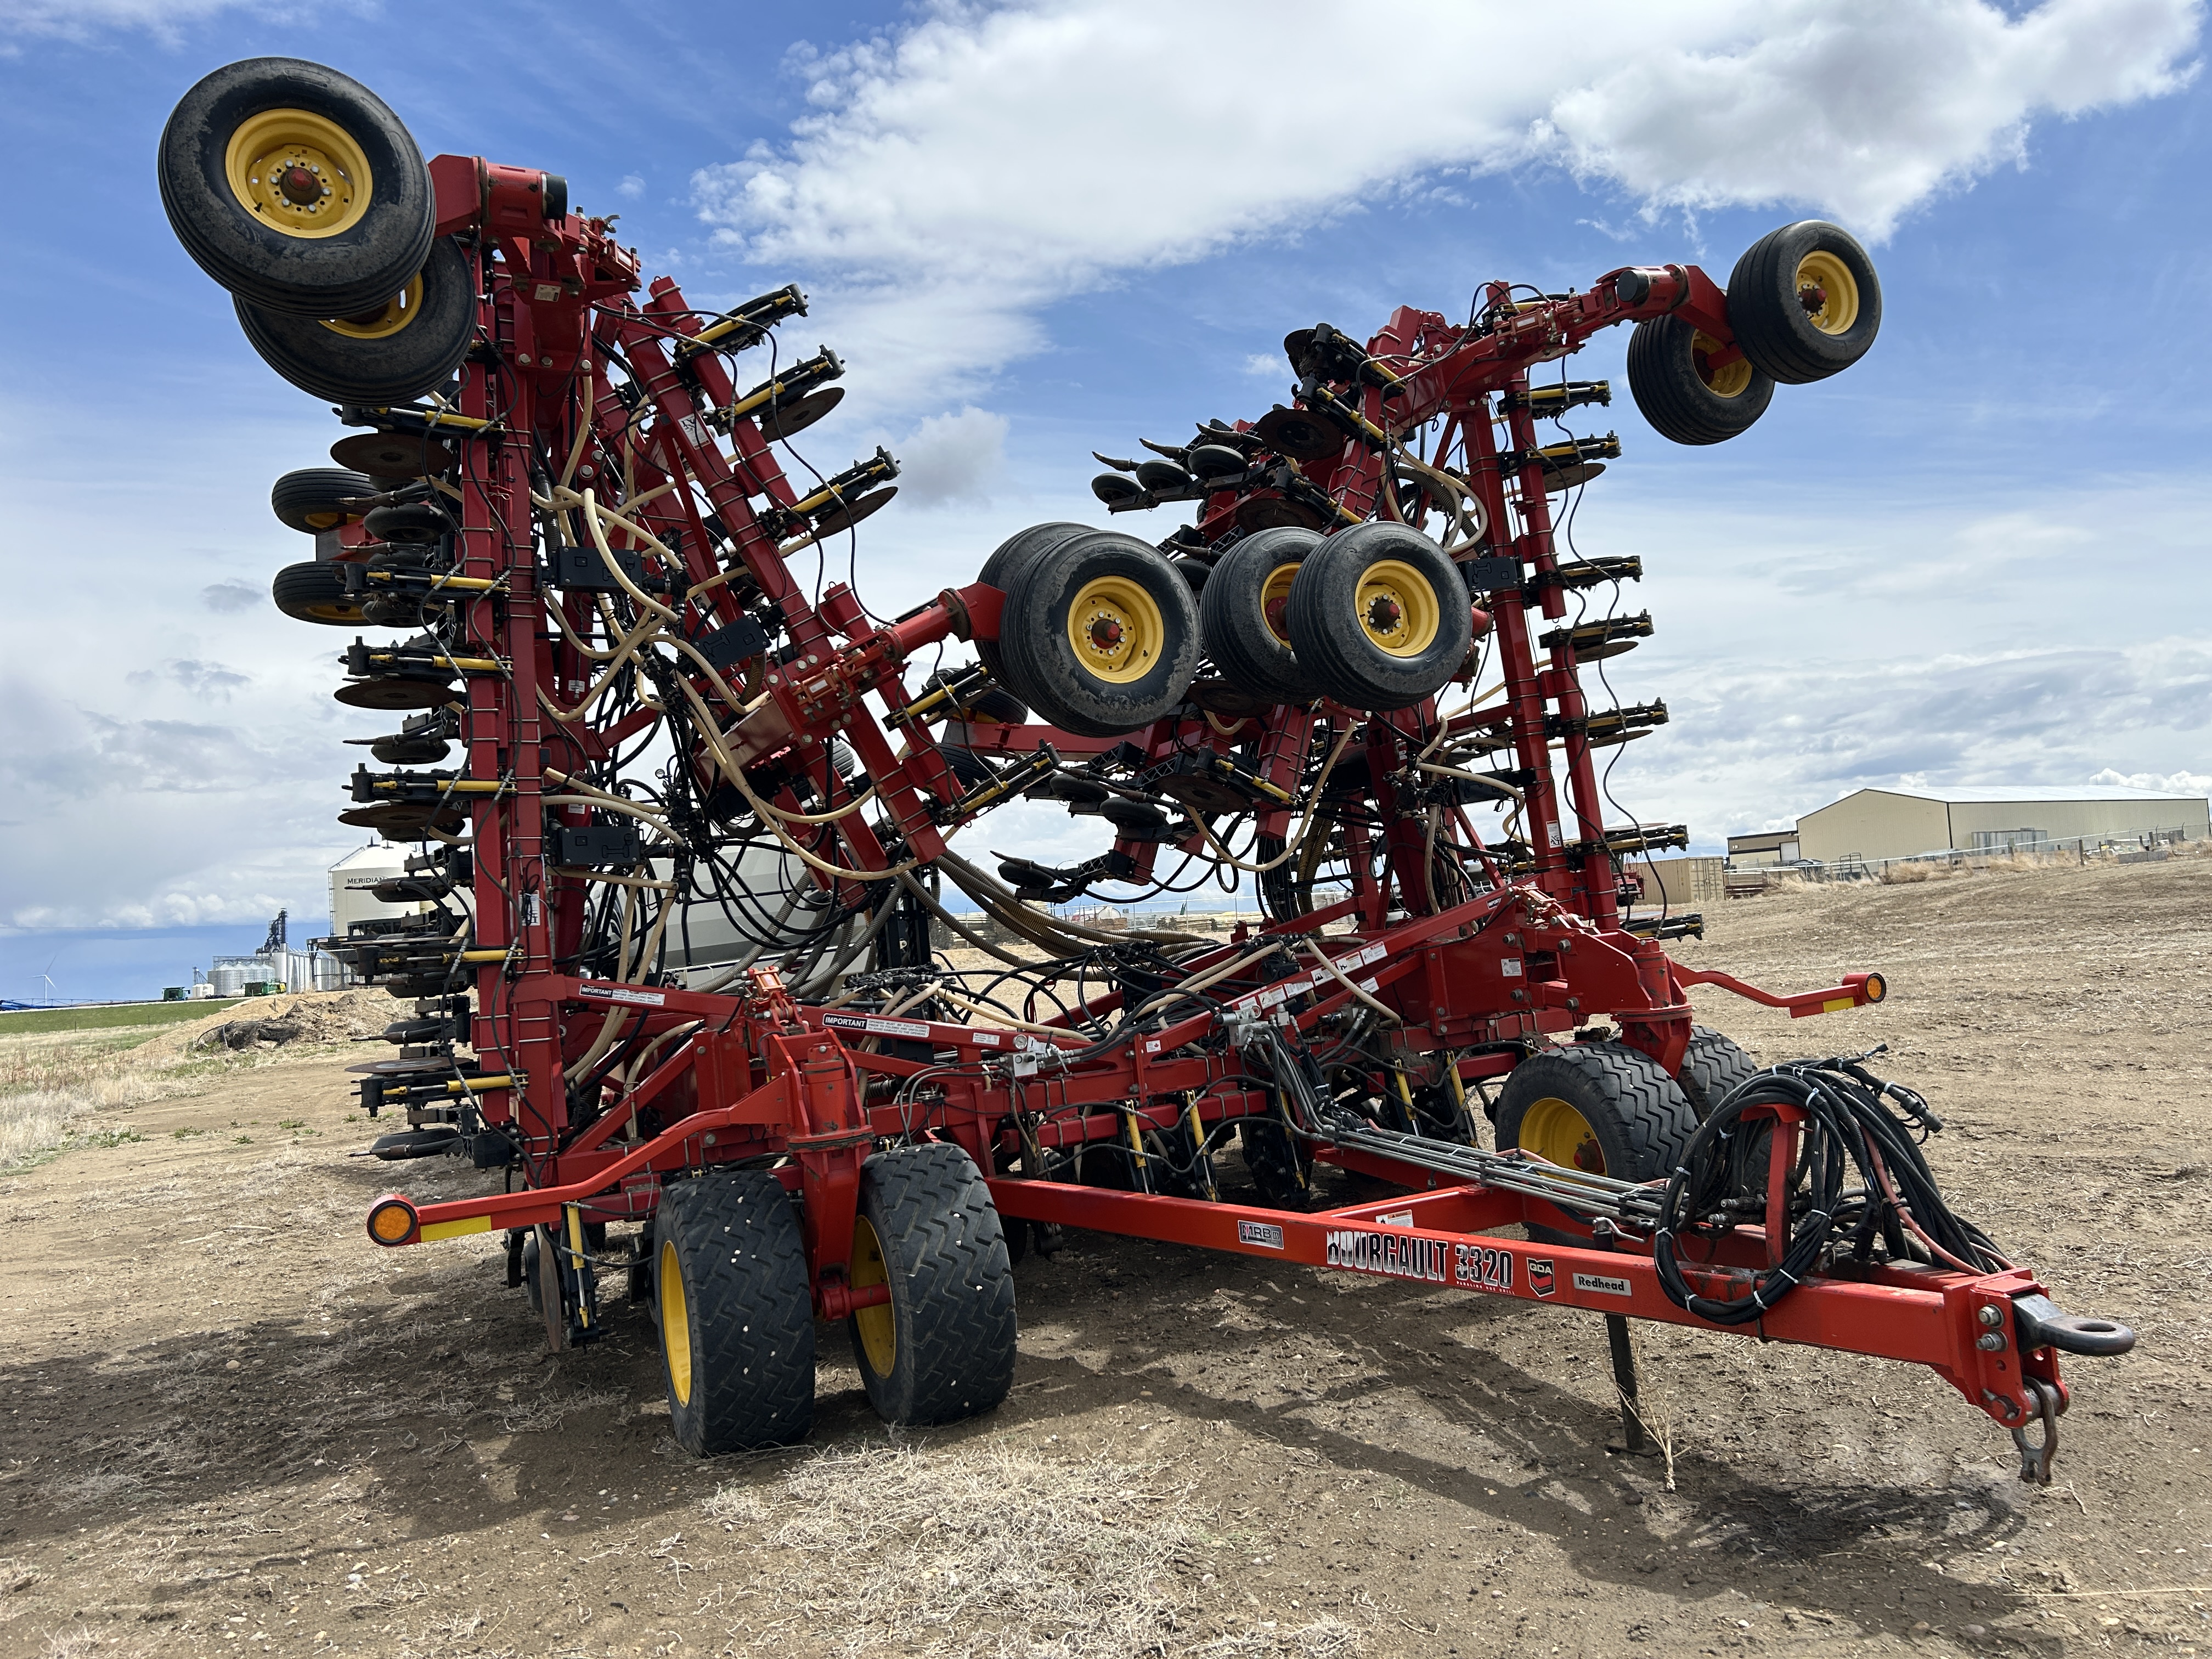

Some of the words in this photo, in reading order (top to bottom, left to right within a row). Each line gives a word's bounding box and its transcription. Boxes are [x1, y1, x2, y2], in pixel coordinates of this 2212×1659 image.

[582, 987, 612, 995] IMPORTANT
[825, 1017, 866, 1028] IMPORTANT
[1242, 1224, 1271, 1239] MRB
[1327, 1231, 1448, 1282] BOURGAULT
[1455, 1243, 1514, 1289] 3320
[1529, 1263, 1553, 1274] QDA
[1578, 1276, 1625, 1291] Redhead
